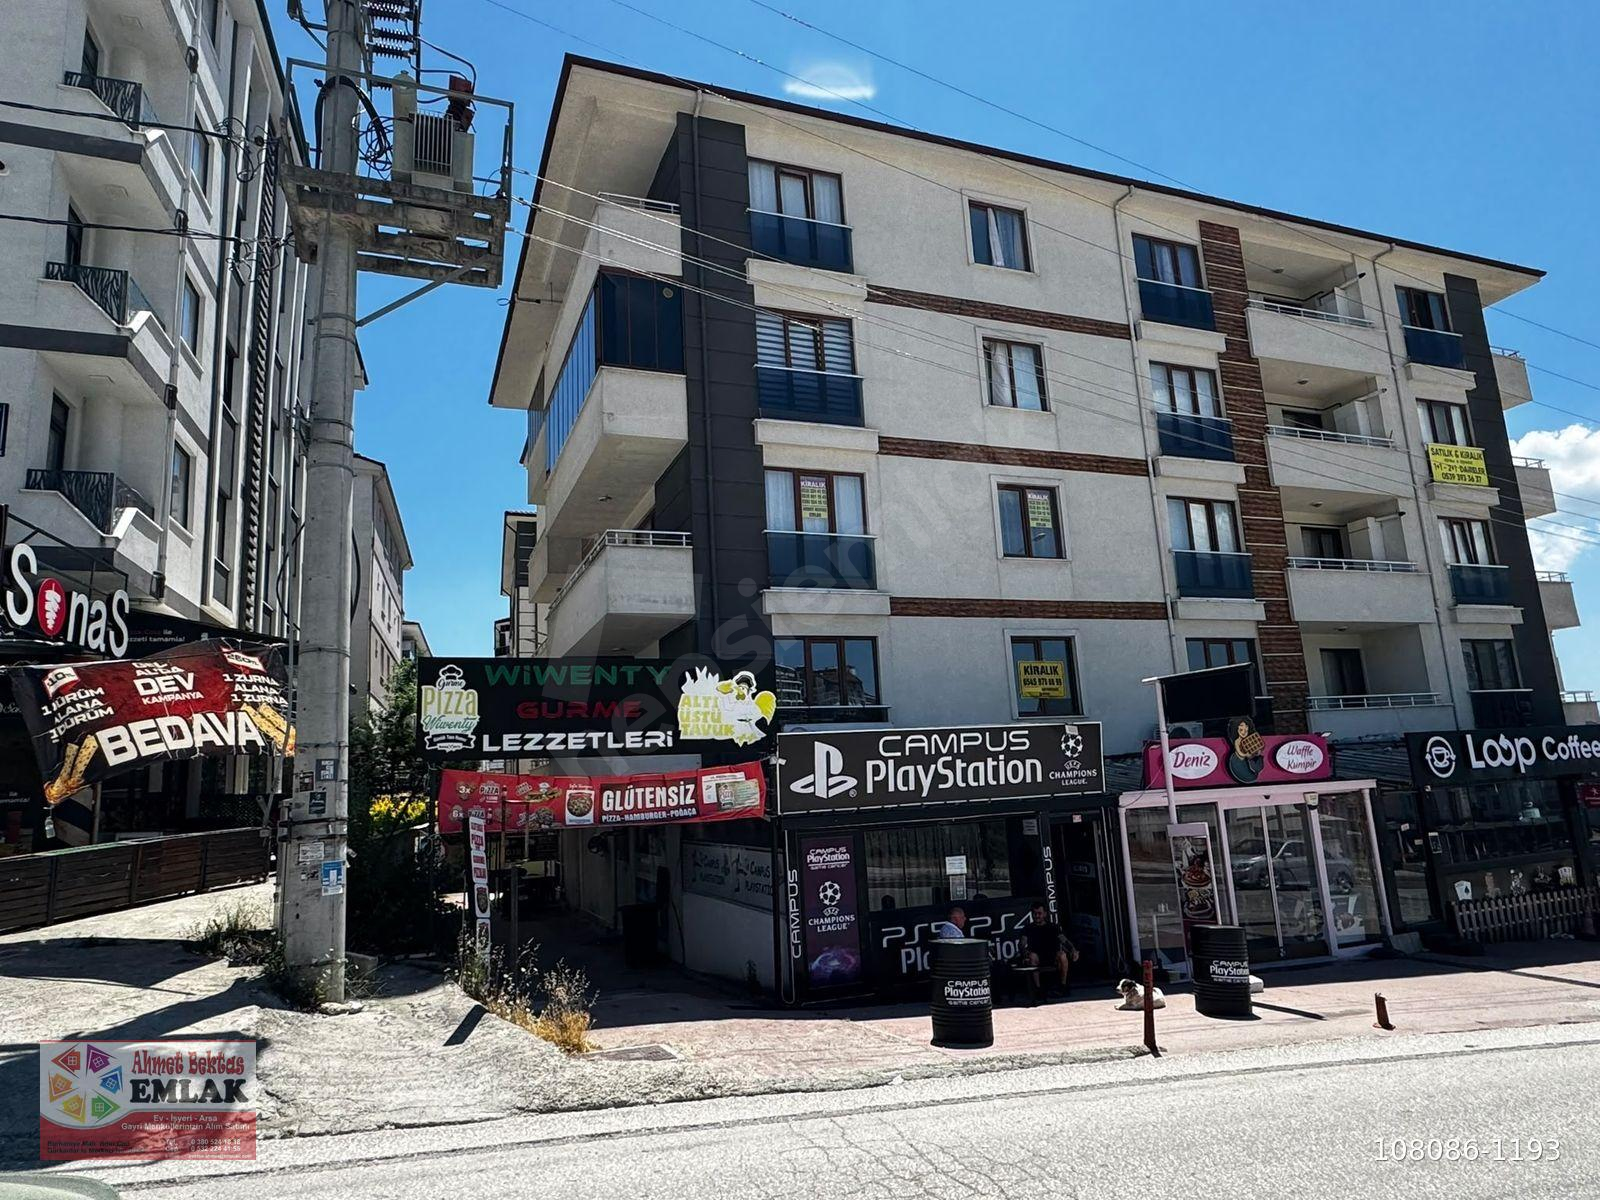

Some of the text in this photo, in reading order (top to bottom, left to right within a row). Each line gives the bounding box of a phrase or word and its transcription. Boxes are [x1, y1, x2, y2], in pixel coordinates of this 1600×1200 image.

[1023, 663, 1059, 676] KİRALIK
[133, 673, 195, 697] DEV
[141, 691, 205, 706] KAMPANYA
[516, 700, 642, 720] GURME
[681, 723, 734, 737] TAVUK
[97, 710, 267, 767] BEDAVA
[878, 730, 1031, 757] CAMPUS
[1286, 744, 1314, 758] Waffle
[1465, 733, 1600, 774] Loop Coffee
[1173, 750, 1212, 770] Deniz
[866, 754, 1043, 798] PlayStation
[1049, 768, 1098, 780] CHAMPIONS
[602, 781, 697, 812] GLÜTENSİZ
[806, 852, 851, 864] PlayStation
[809, 846, 847, 855] CAMPUS
[789, 869, 802, 959] CAMPUS
[808, 914, 856, 926] CHAMPIONS
[947, 979, 989, 988] CAMPUS
[944, 986, 991, 998] PlayStation
